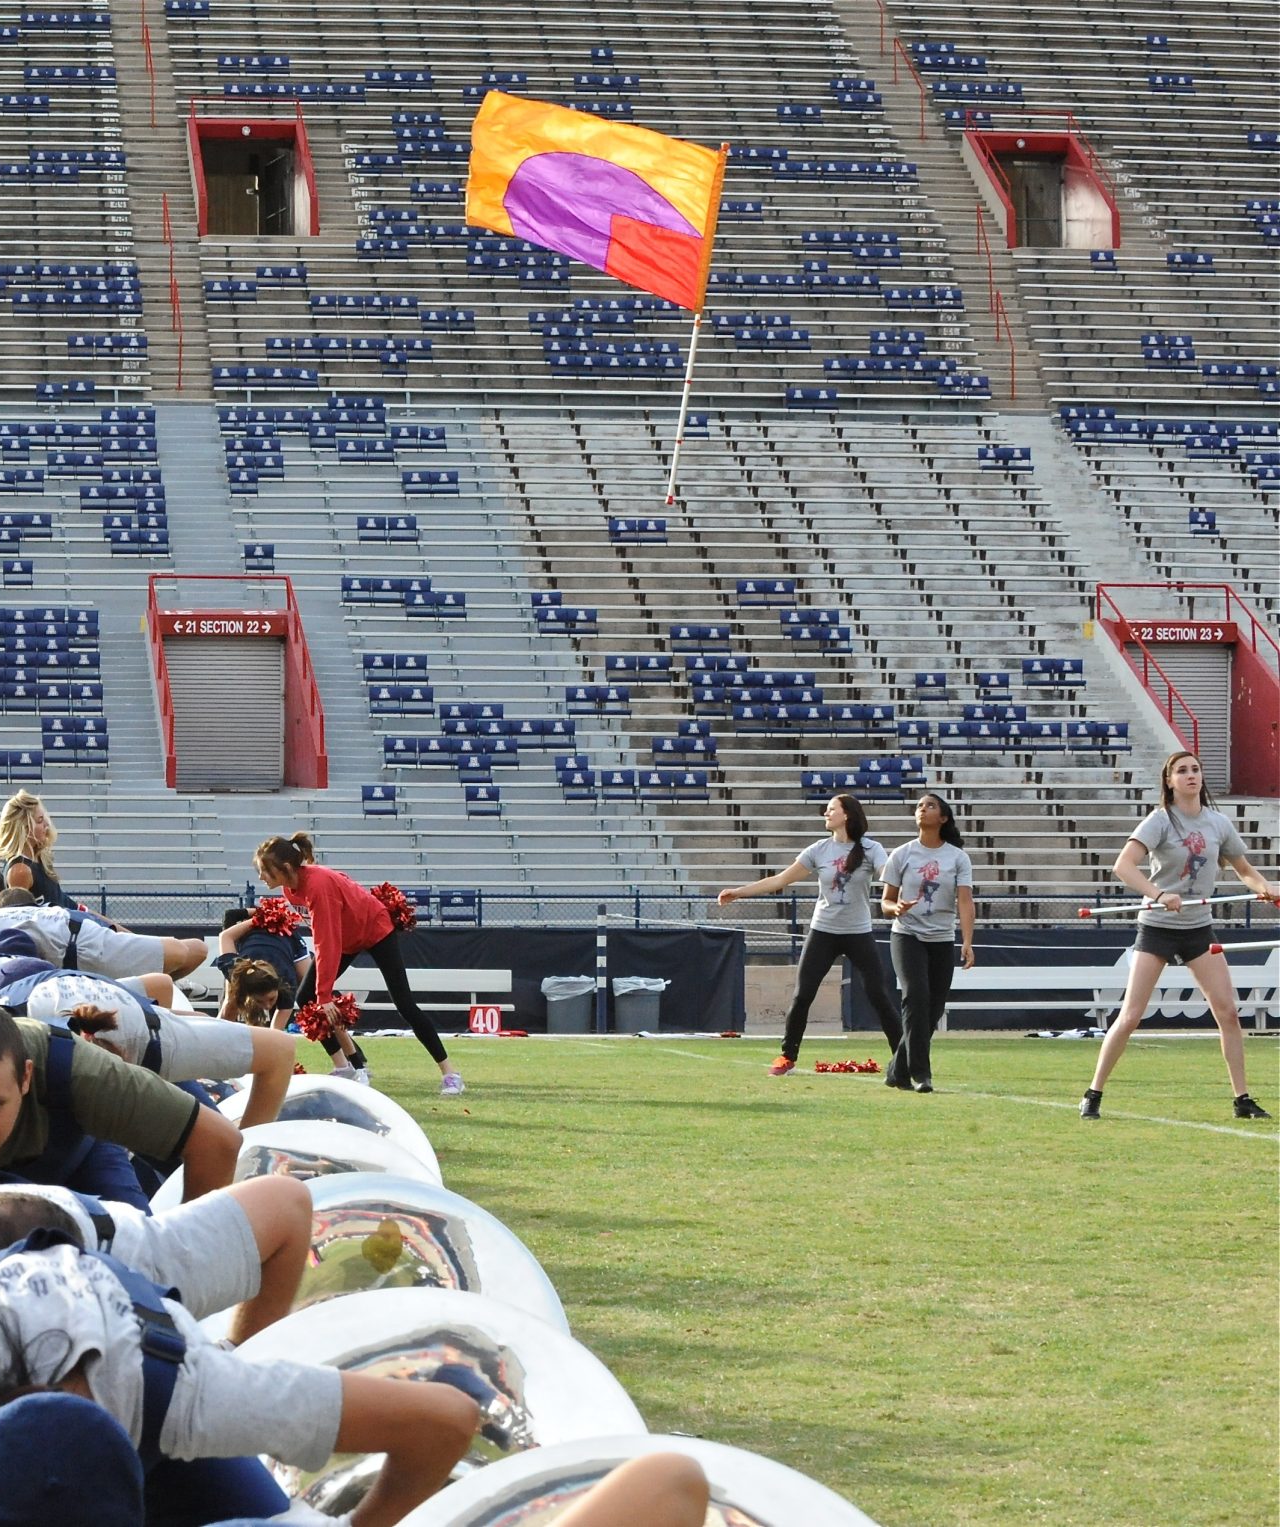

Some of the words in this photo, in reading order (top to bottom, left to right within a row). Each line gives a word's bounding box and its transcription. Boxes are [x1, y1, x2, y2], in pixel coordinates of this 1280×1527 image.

[185, 620, 196, 633] 21
[199, 620, 243, 633] SECTION
[246, 620, 259, 633] 22
[1141, 627, 1153, 640] 22
[1156, 627, 1197, 640] SECTION
[1200, 627, 1212, 640] 23
[472, 1007, 499, 1033] 40
